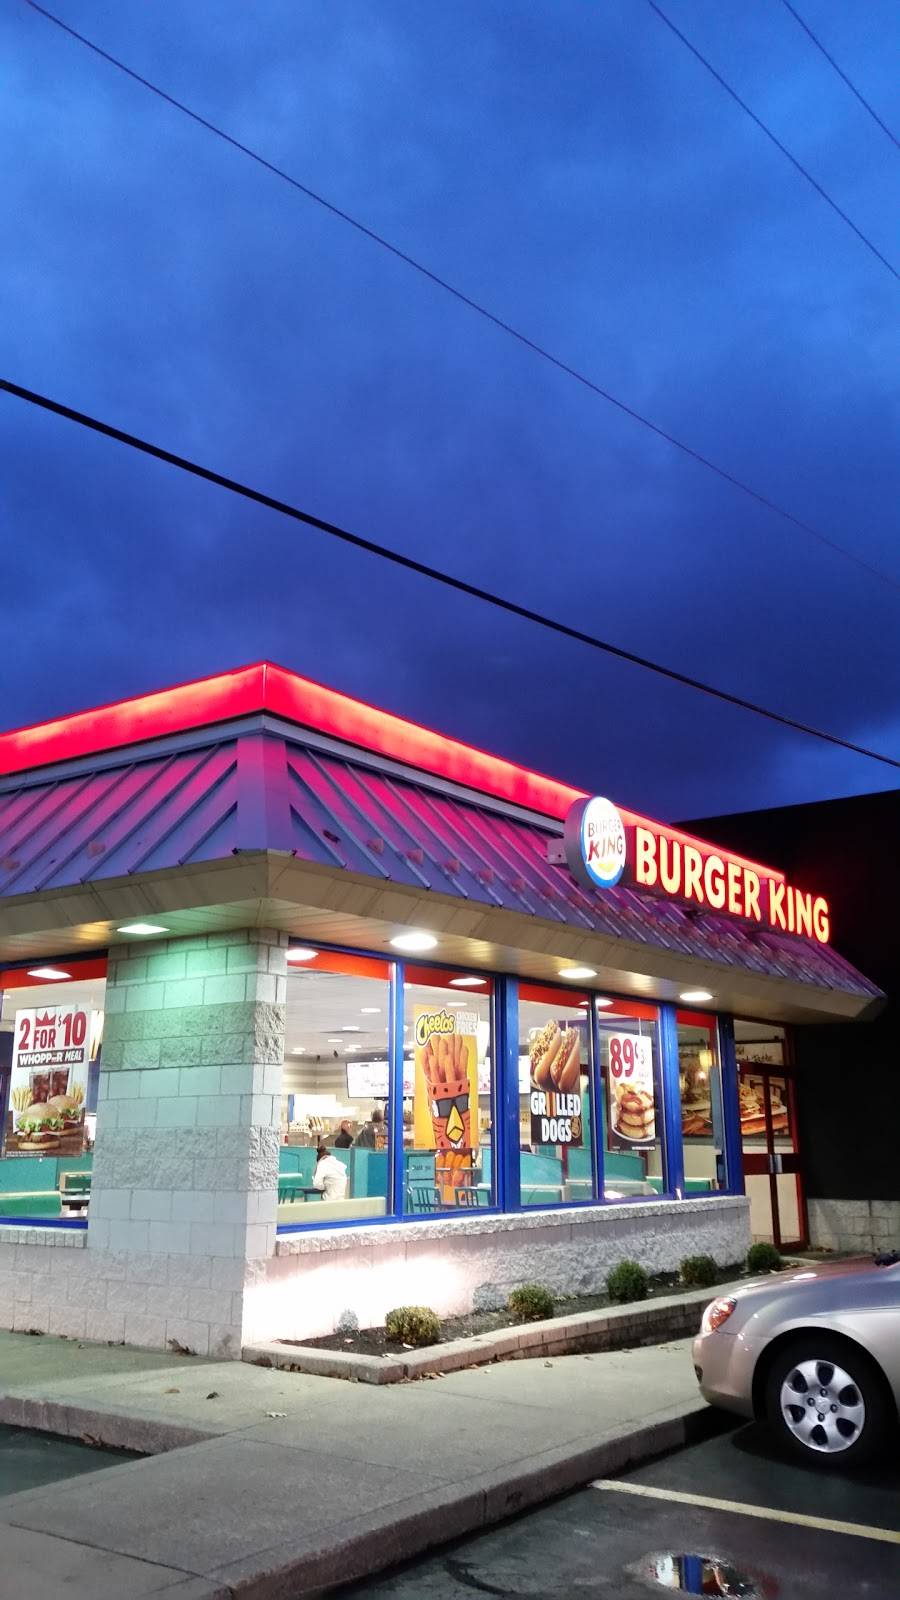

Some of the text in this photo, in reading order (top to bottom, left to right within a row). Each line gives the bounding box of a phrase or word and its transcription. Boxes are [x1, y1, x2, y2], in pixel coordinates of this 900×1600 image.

[588, 817, 620, 838] BURGER
[588, 835, 623, 862] KING
[635, 825, 830, 944] BURGER KING
[18, 1011, 87, 1051] 2 FOR $10
[416, 1009, 456, 1047] Cheetos
[64, 1049, 82, 1061] MEAL
[530, 1091, 581, 1117] GRILLED
[541, 1118, 572, 1142] DOGS
